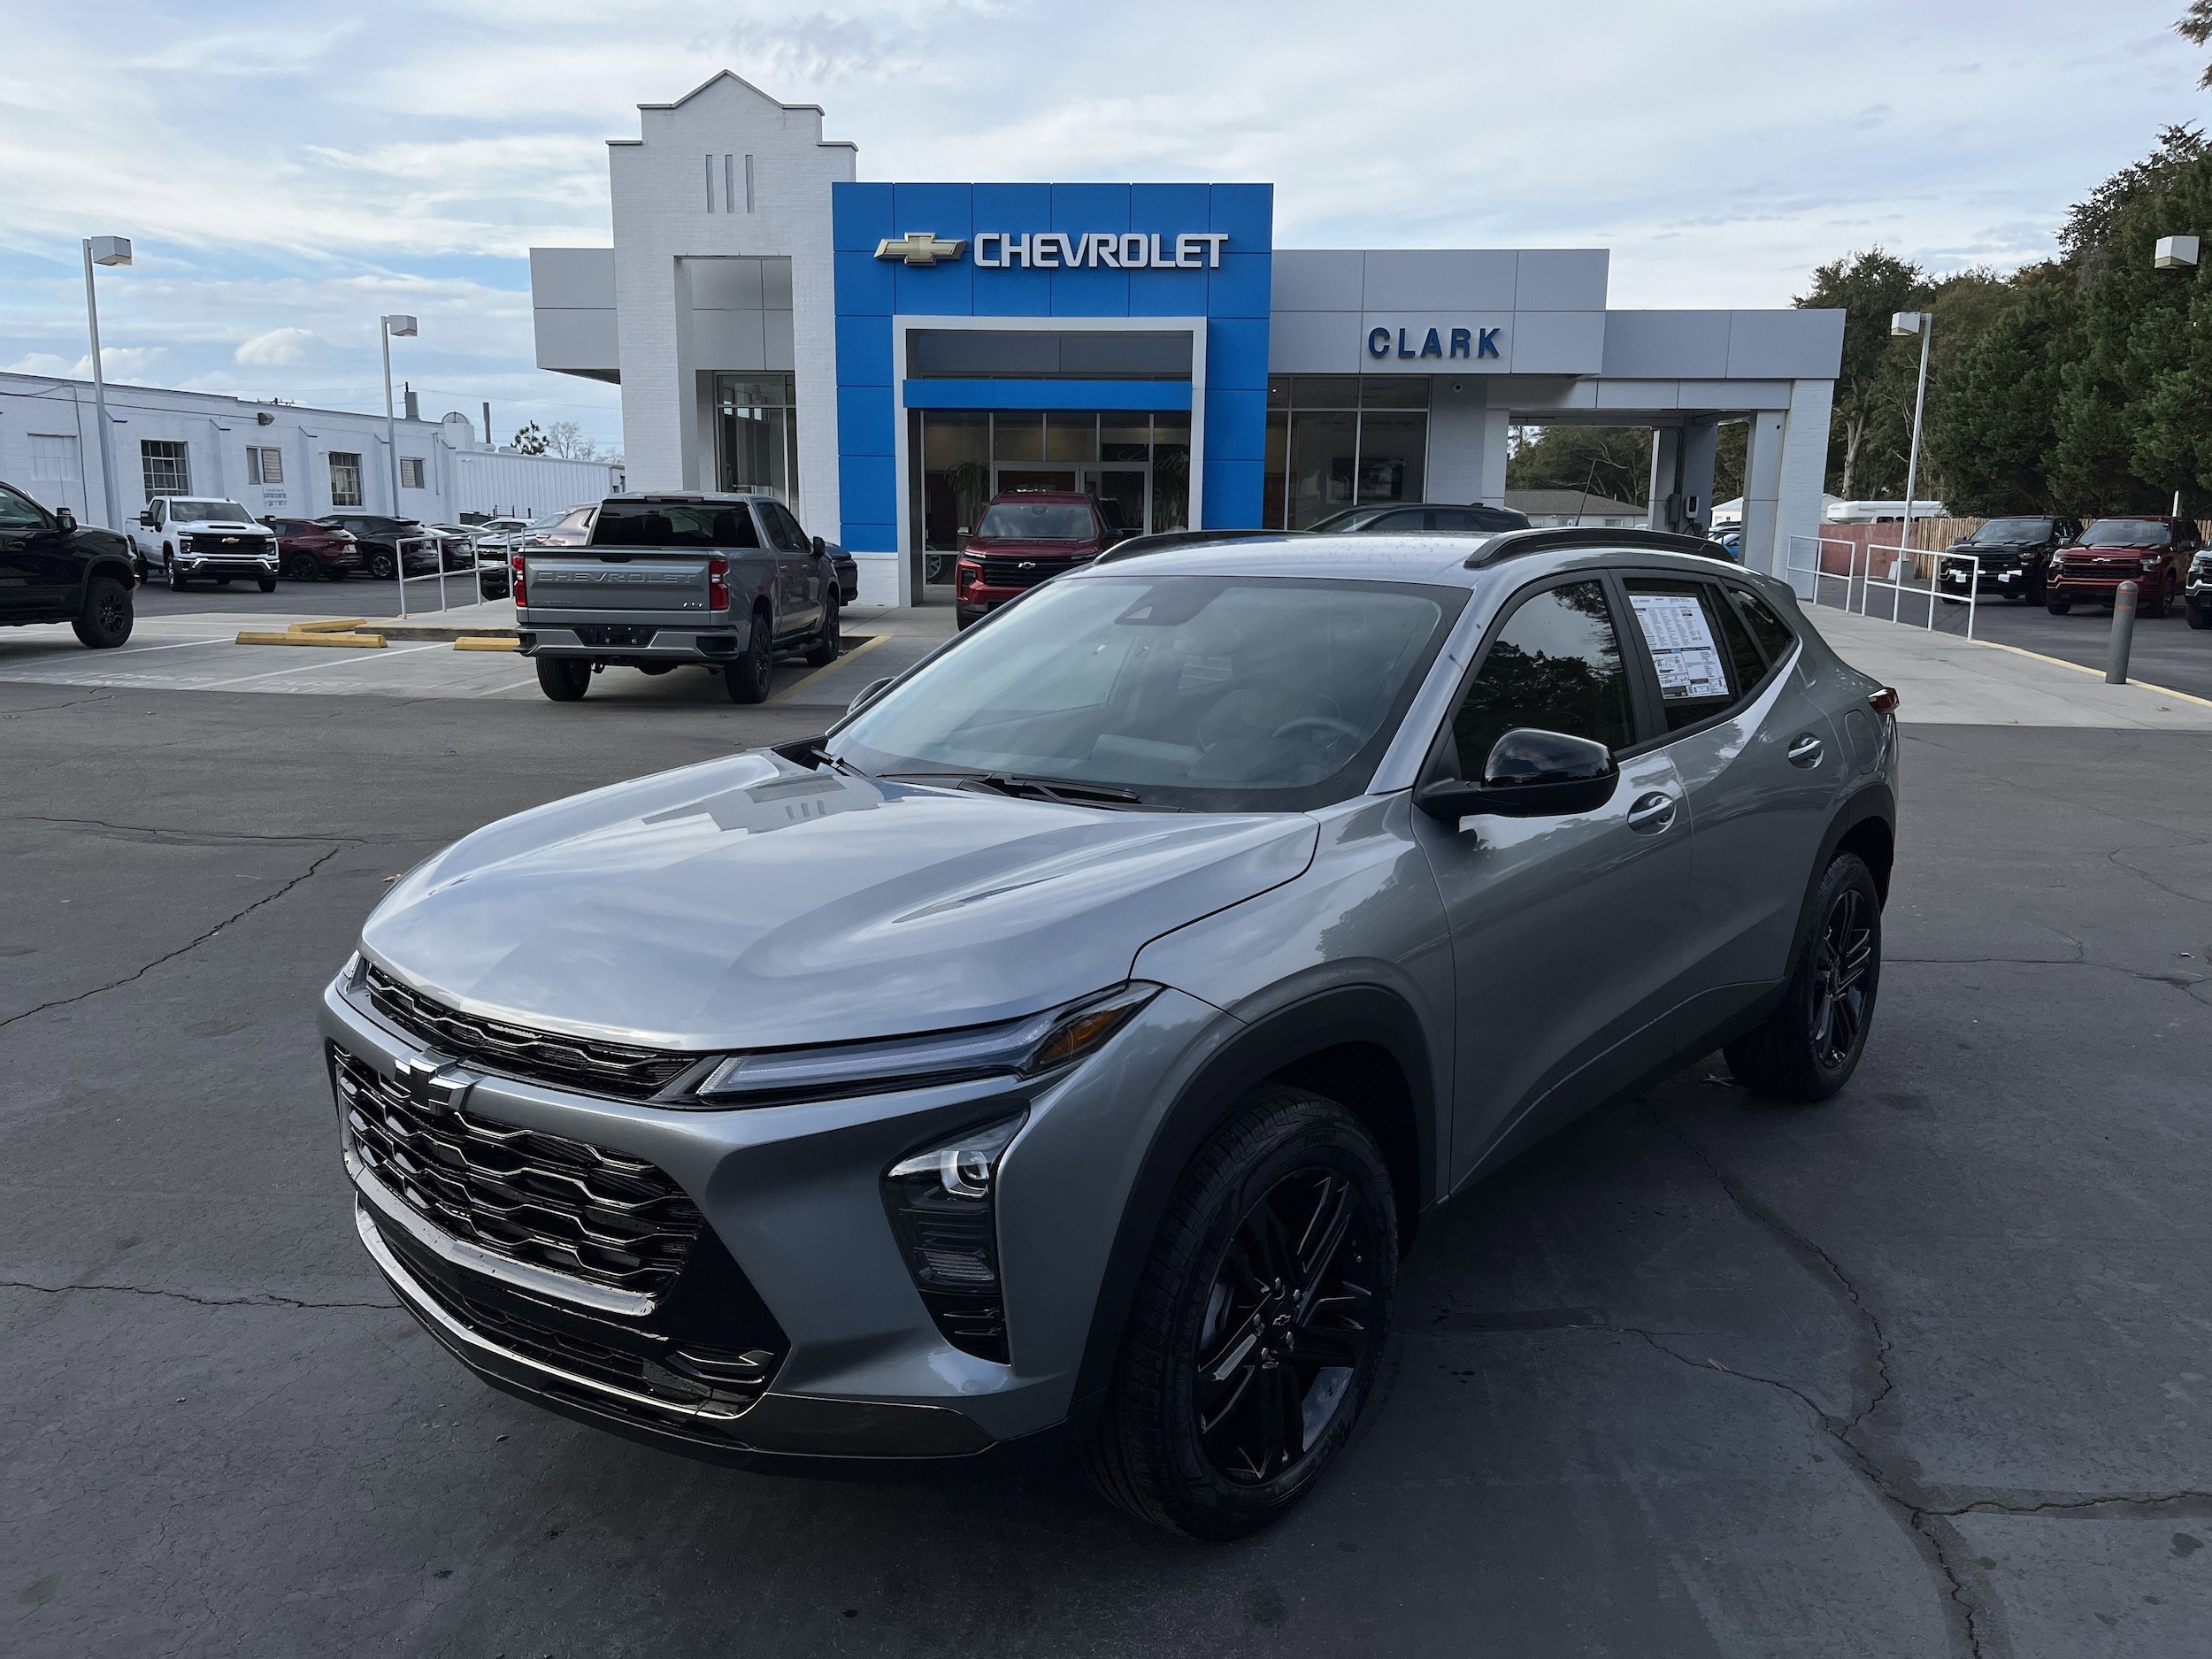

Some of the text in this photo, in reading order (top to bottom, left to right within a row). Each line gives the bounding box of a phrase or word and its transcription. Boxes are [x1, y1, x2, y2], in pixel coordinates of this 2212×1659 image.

[972, 232, 1229, 269] CHEVROLET
[1368, 326, 1502, 358] CLARK
[537, 571, 696, 584] CHEVROLET
